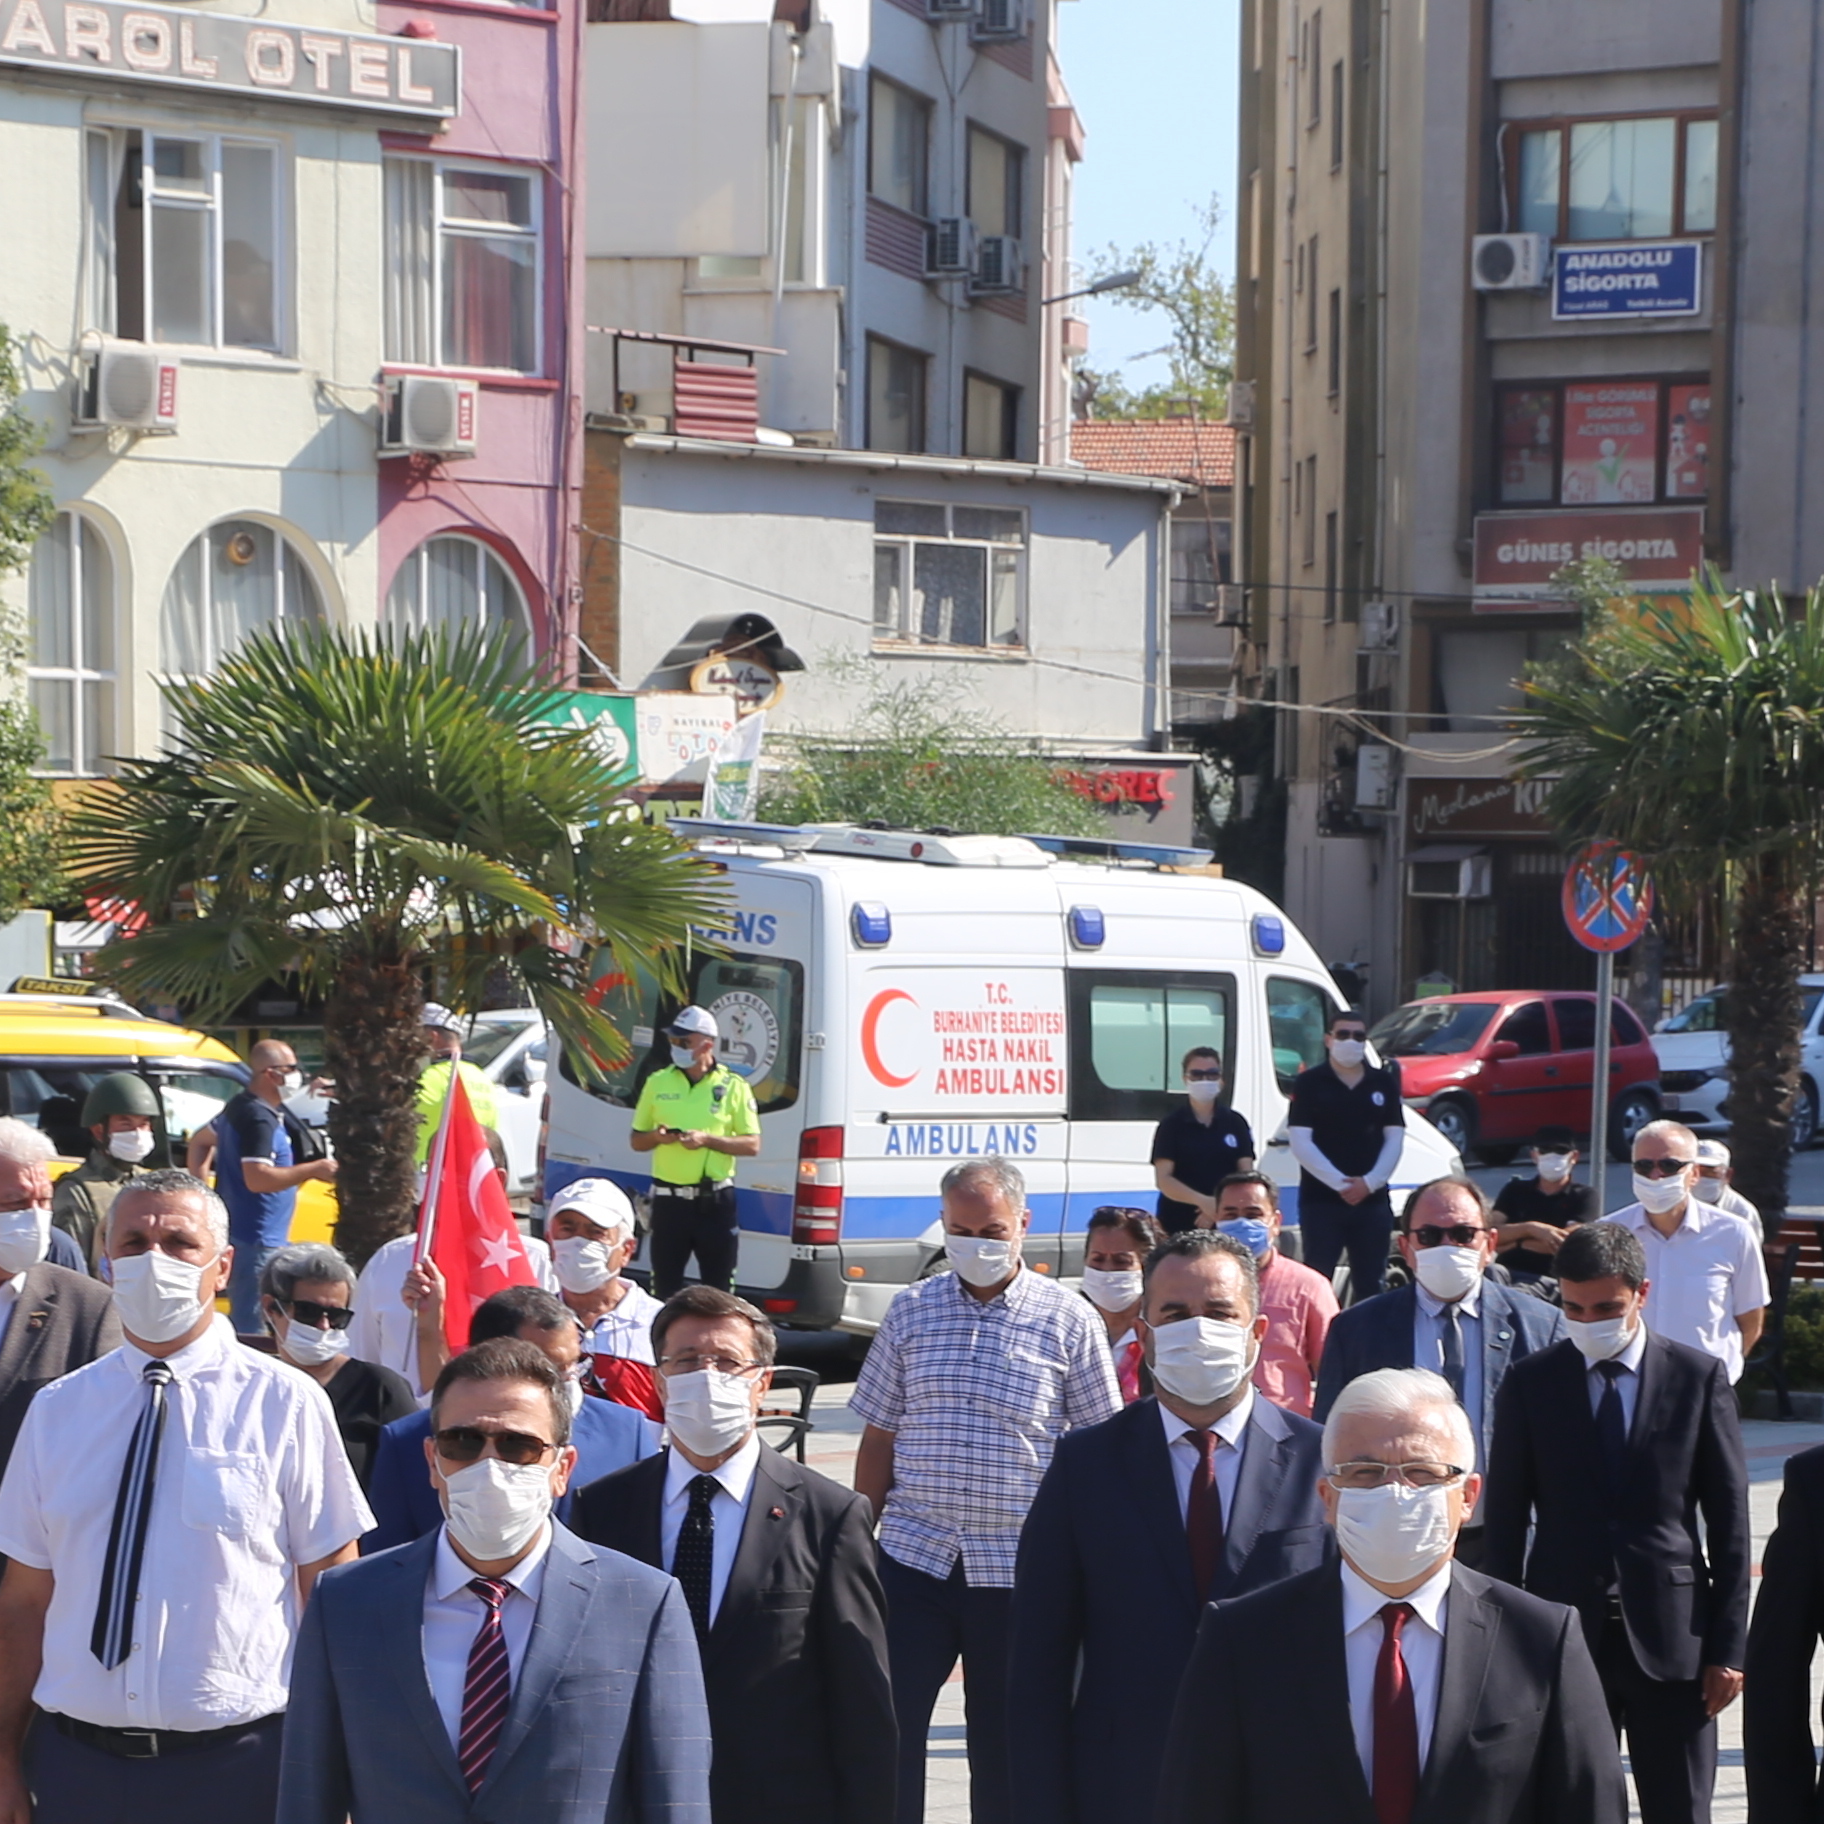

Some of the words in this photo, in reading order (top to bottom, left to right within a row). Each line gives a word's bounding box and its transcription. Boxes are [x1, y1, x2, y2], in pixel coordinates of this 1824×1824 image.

[245, 28, 434, 101] OTEL
[1565, 250, 1673, 271] ANADOLU
[1564, 271, 1659, 293] SİGORTA
[985, 983, 1013, 1004] T.C.
[933, 1006, 997, 1033] BURHANİYE
[1001, 1006, 1064, 1034] BELEDİYESİ
[942, 1038, 998, 1063] HASTA
[934, 1068, 1065, 1095] AMBULANSI
[884, 1123, 1038, 1156] AMBULANS
